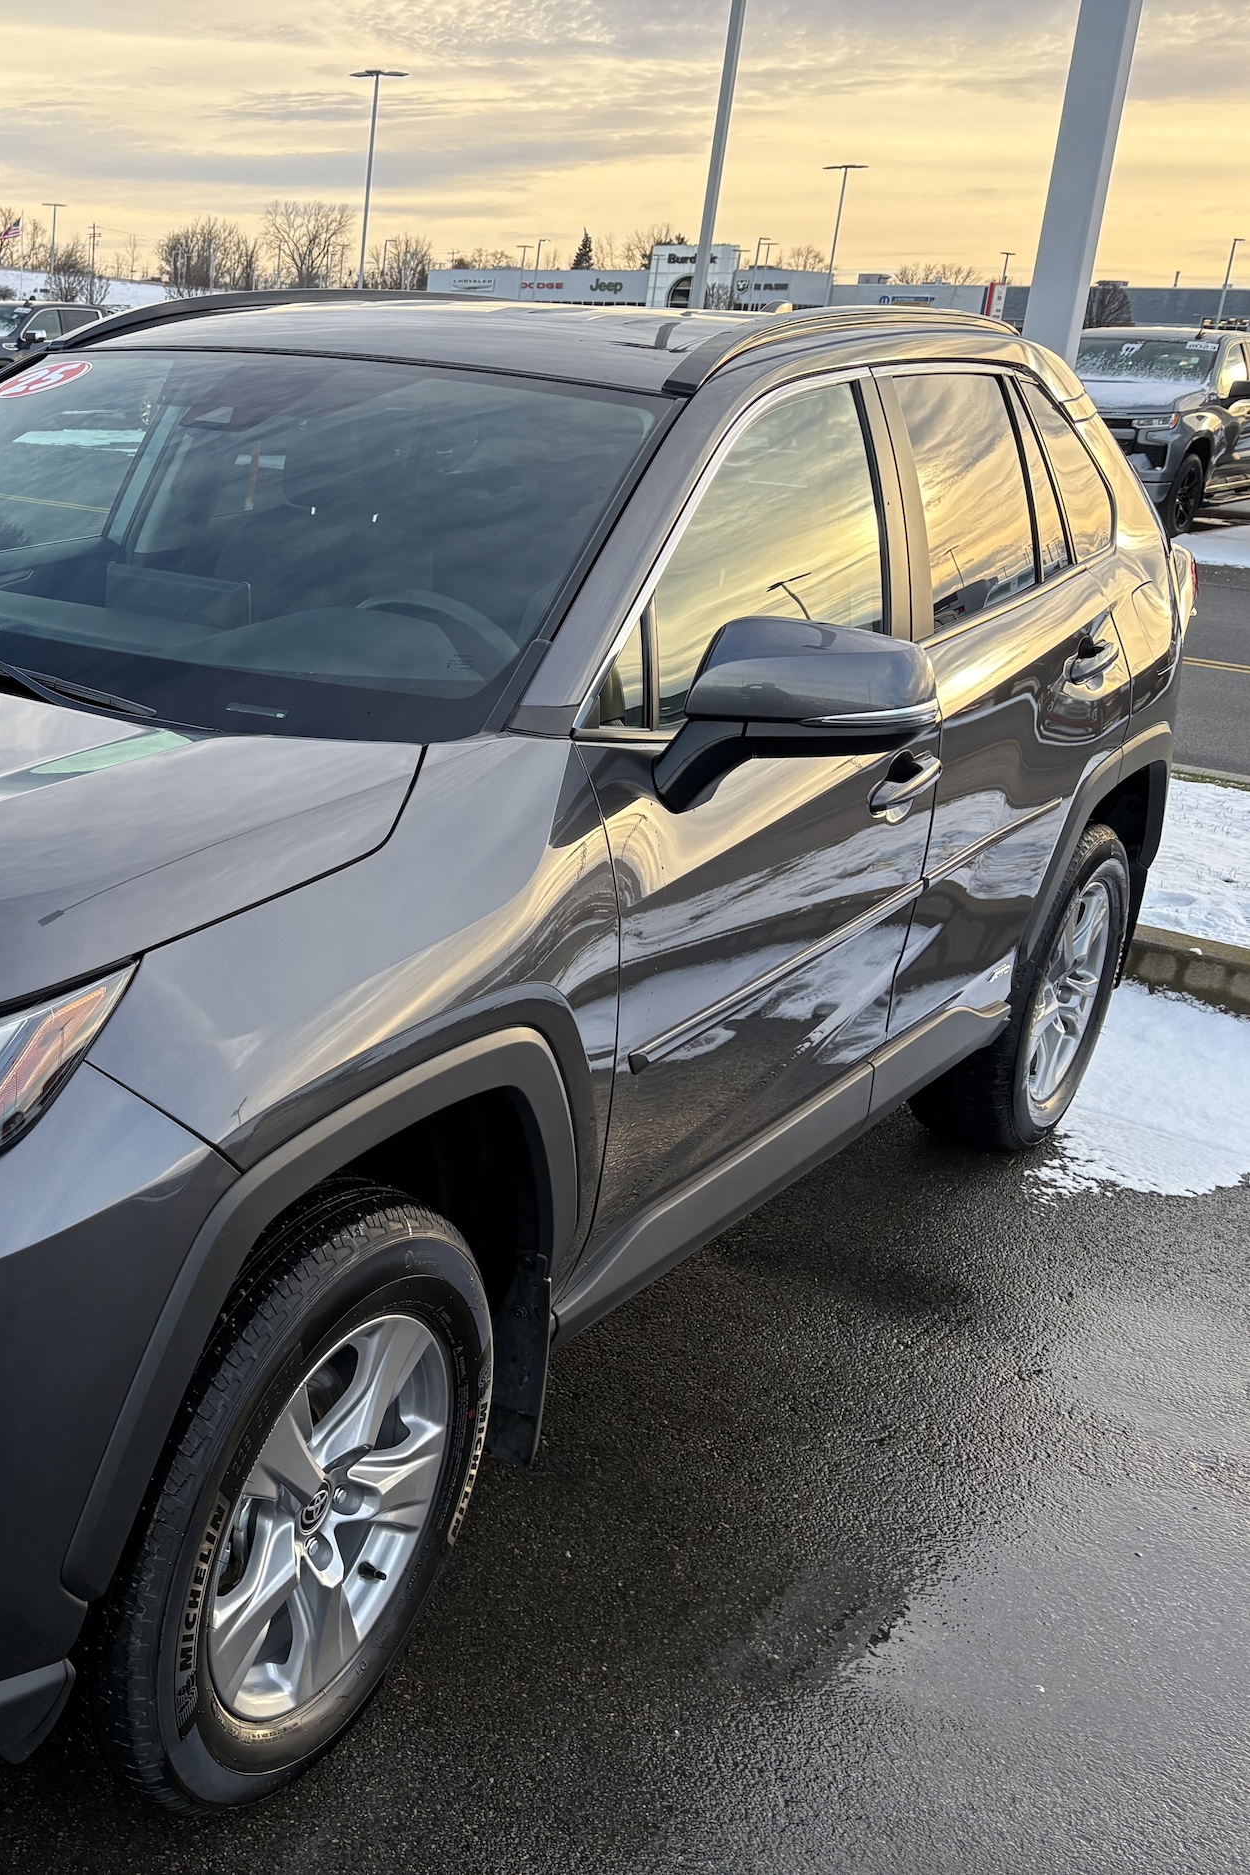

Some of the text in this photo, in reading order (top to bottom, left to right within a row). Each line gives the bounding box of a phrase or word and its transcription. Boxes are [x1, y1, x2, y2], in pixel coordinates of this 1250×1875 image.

[667, 253, 718, 264] Burdk
[590, 278, 623, 294] Jeep
[0, 362, 83, 396] 25
[451, 1401, 488, 1538] MICHELIN
[179, 1503, 226, 1672] MICHELIN
